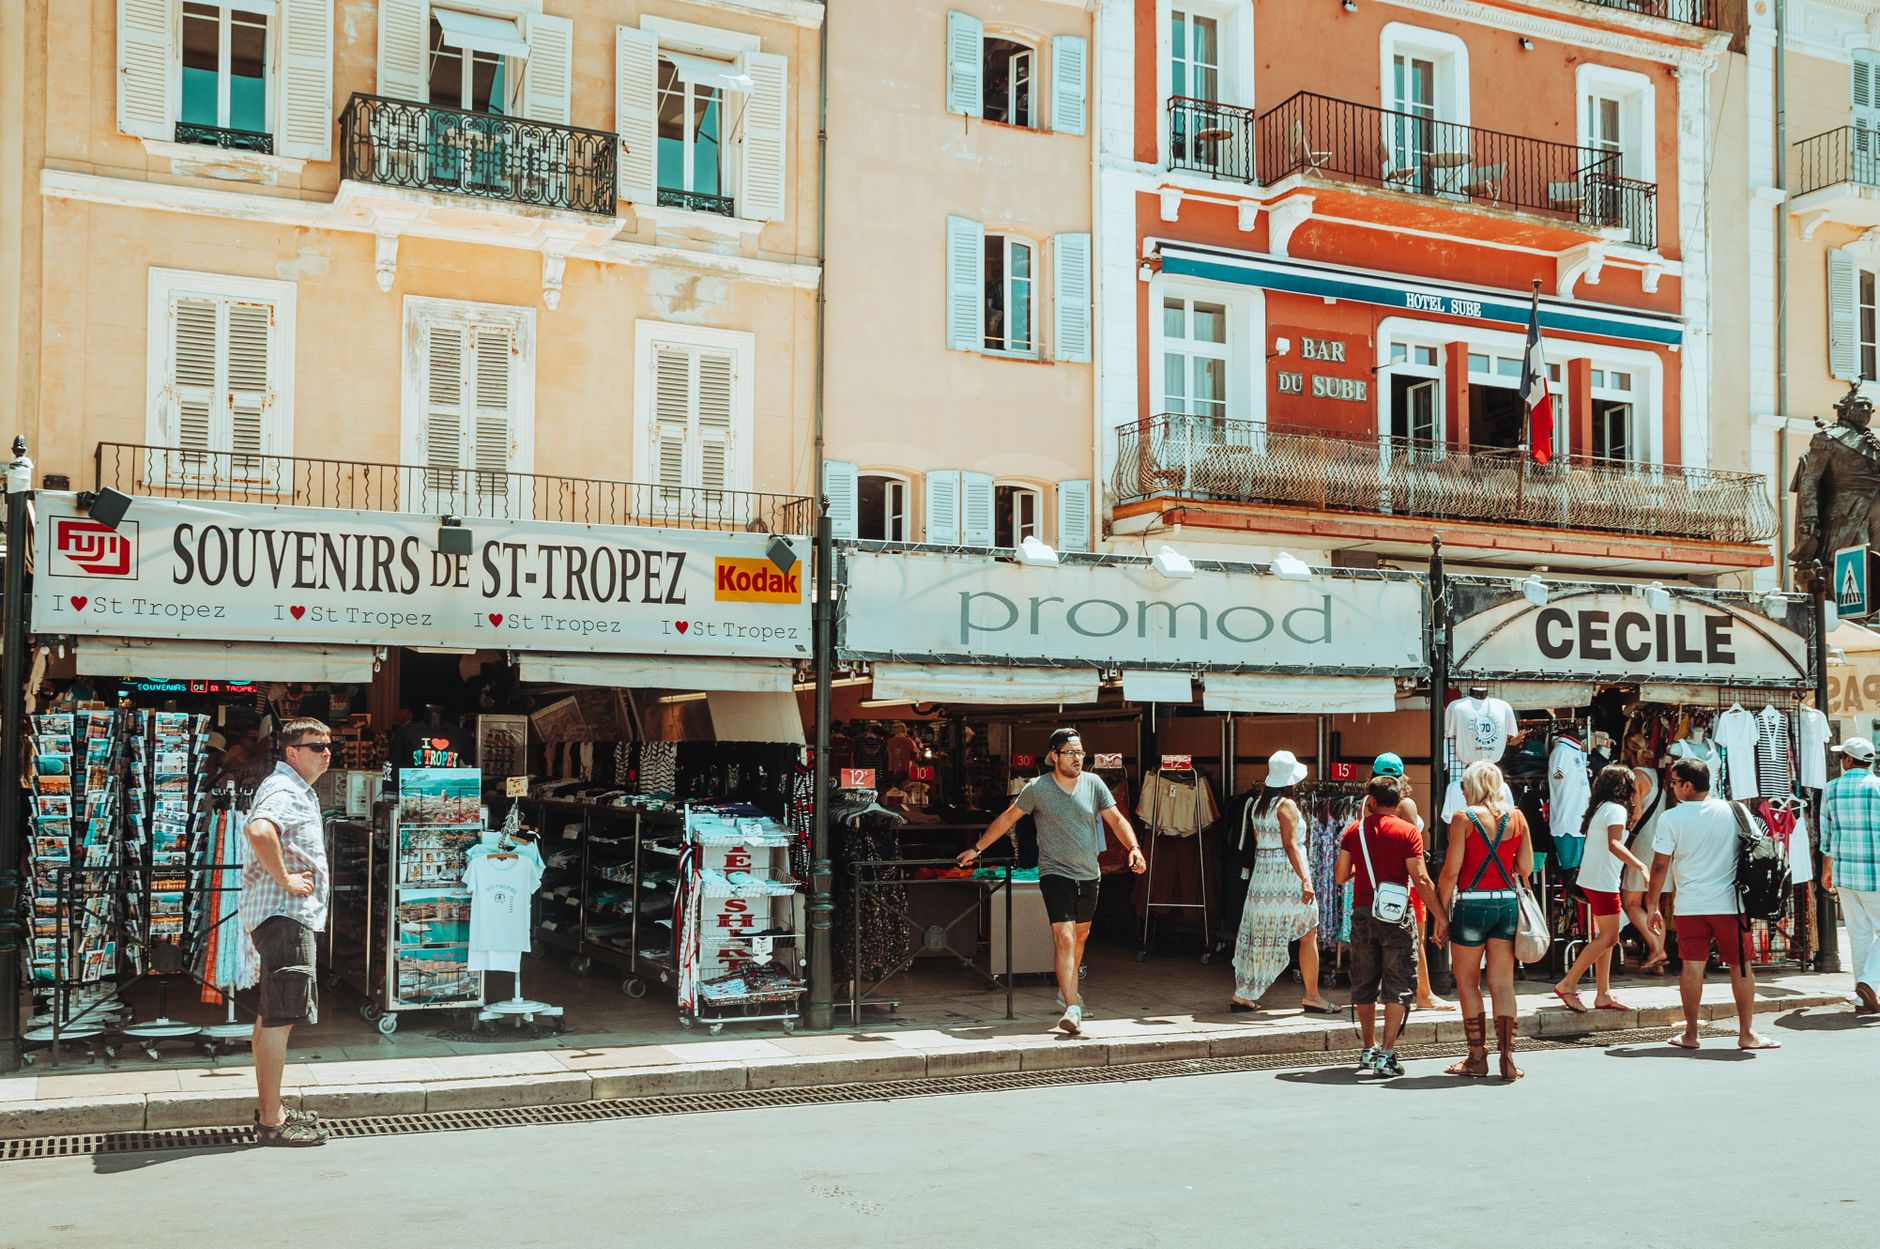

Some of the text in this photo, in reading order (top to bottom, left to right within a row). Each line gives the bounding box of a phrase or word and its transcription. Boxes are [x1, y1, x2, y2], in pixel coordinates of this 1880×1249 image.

[1406, 293, 1481, 317] HOTEL SUBE
[1303, 338, 1345, 362] BAR
[1278, 374, 1367, 400] DU SUBE
[173, 523, 687, 606] SOUVENIRS DE ST-TROPEZ
[718, 565, 798, 594] Kodak
[53, 595, 226, 621] I St Tropez
[274, 605, 432, 629] I St Tropez
[959, 591, 1332, 645] promod
[474, 612, 621, 636] I St Tropez
[662, 620, 798, 642] I St Tropez
[1536, 607, 1736, 664] CECILE
[137, 684, 187, 692] SOUVENIRS
[421, 737, 432, 749] I
[413, 749, 459, 767] ST TROPEZ
